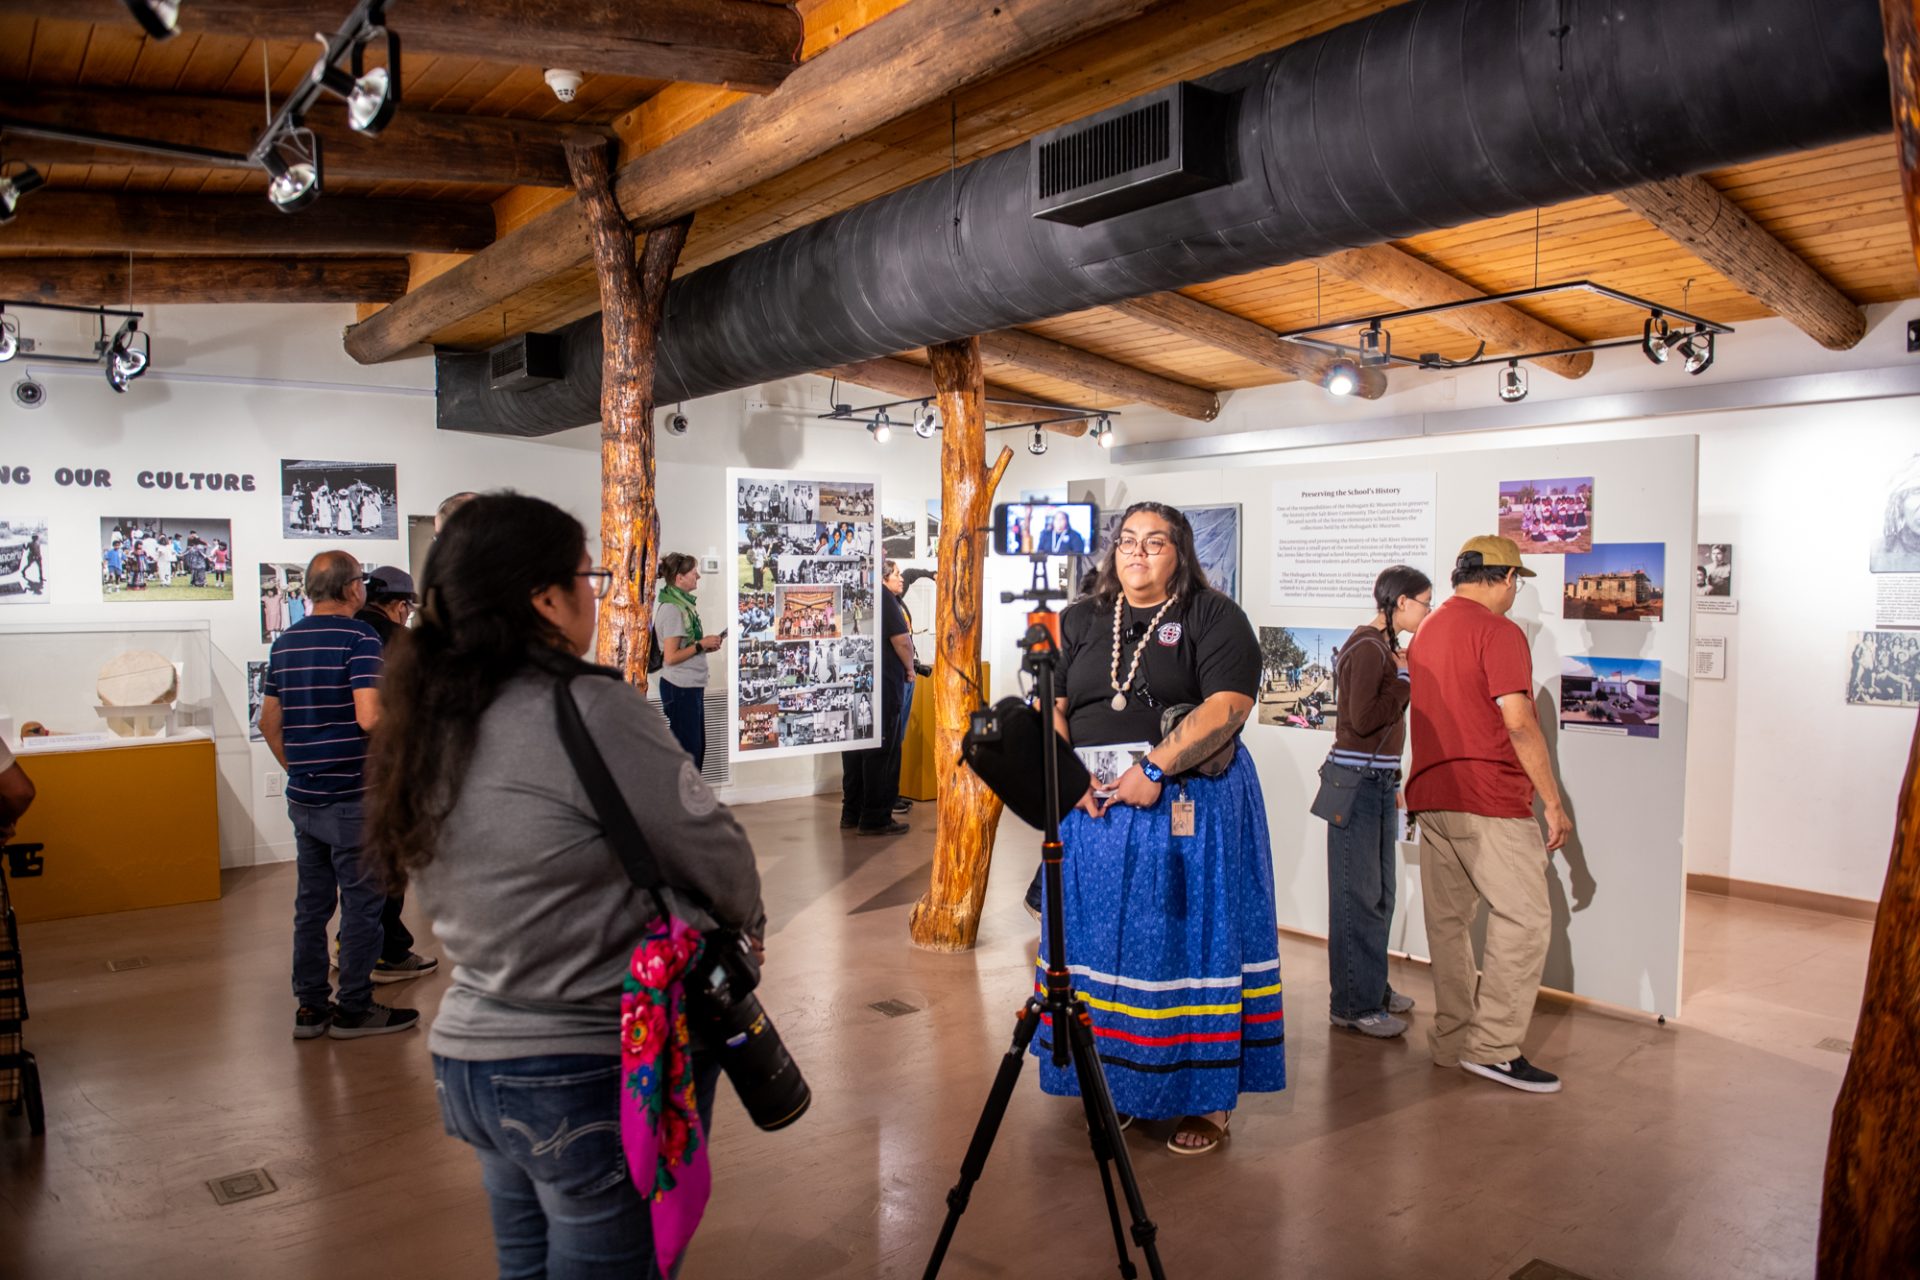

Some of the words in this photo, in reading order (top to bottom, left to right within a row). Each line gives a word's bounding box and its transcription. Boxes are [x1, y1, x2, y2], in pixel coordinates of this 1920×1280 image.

[54, 467, 111, 487] OUR
[137, 470, 256, 491] CULTURE
[1347, 488, 1374, 496] School's
[1375, 487, 1400, 495] History
